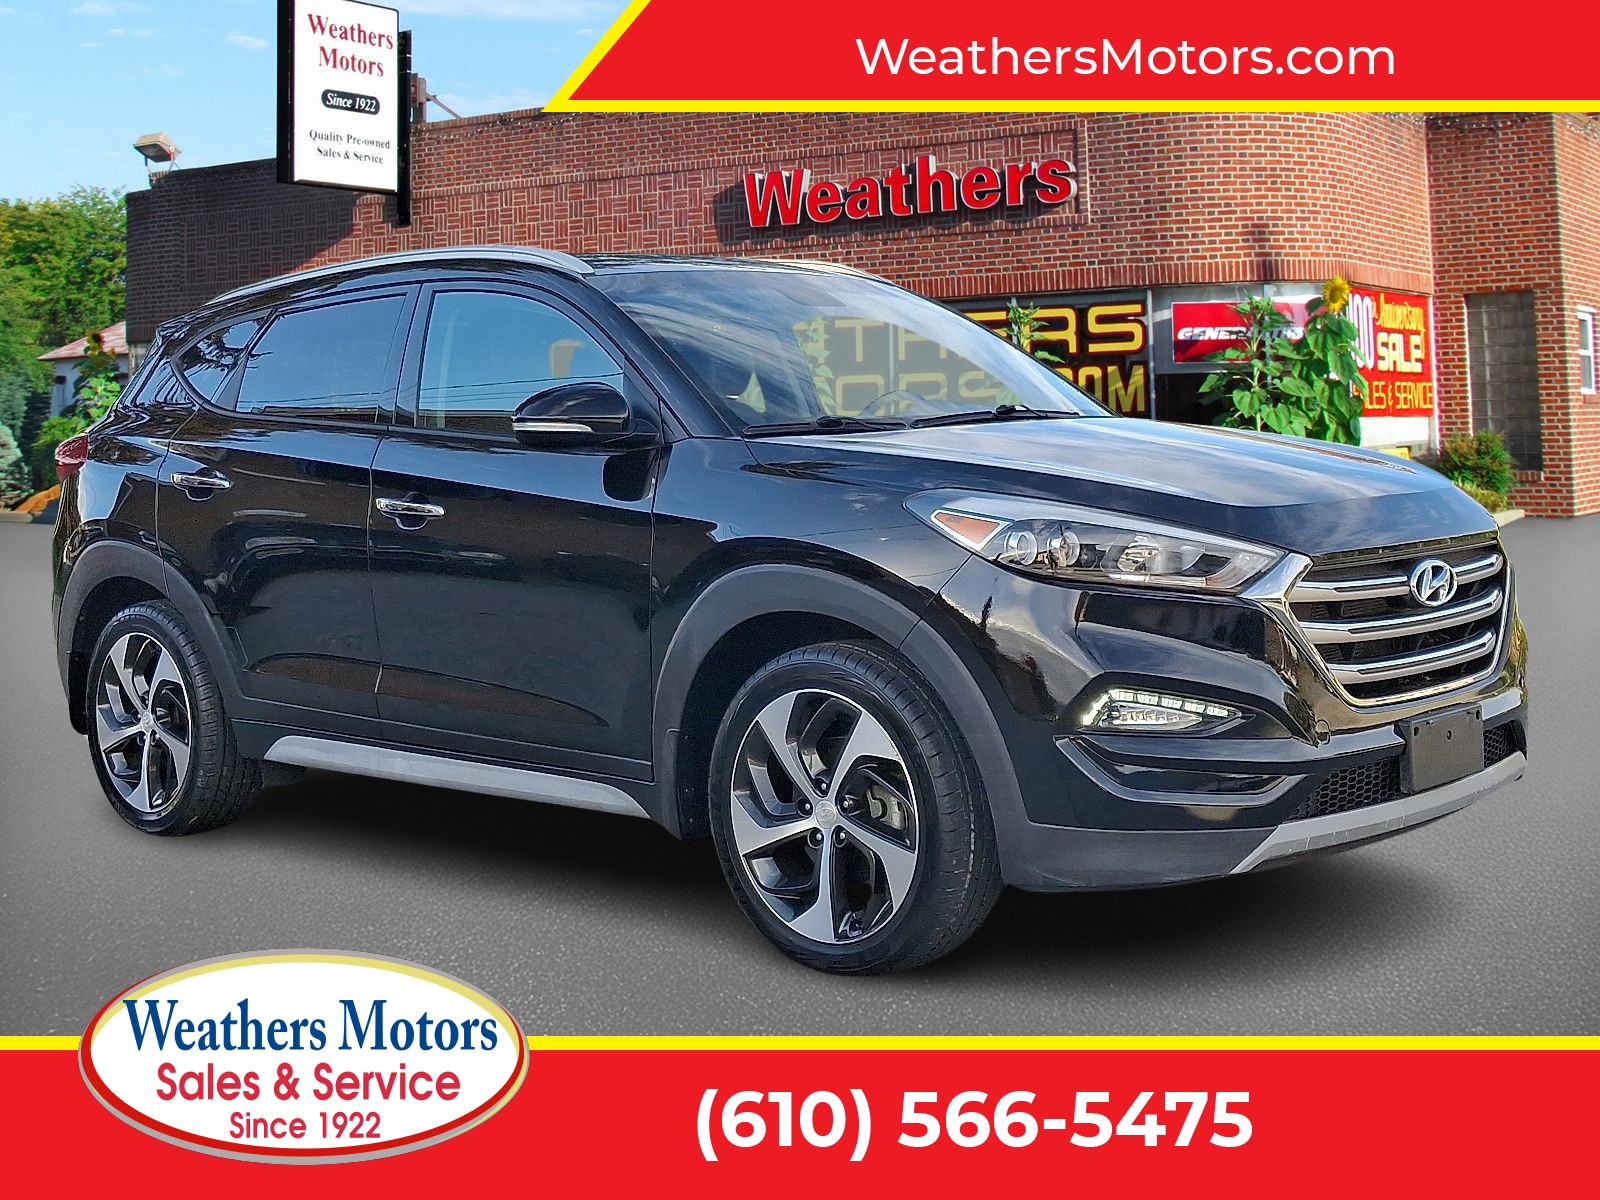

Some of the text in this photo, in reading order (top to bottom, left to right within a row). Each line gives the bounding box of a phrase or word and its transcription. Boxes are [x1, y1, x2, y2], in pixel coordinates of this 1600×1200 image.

[307, 13, 394, 51] Weathers
[318, 45, 384, 77] Motors
[326, 92, 377, 113] Since 1922
[309, 129, 391, 150] Quality Pre-owned
[316, 145, 384, 164] Sales & Service
[743, 154, 1077, 229] Weathers
[1376, 331, 1424, 373] SALE
[1394, 381, 1434, 410] SERVICE
